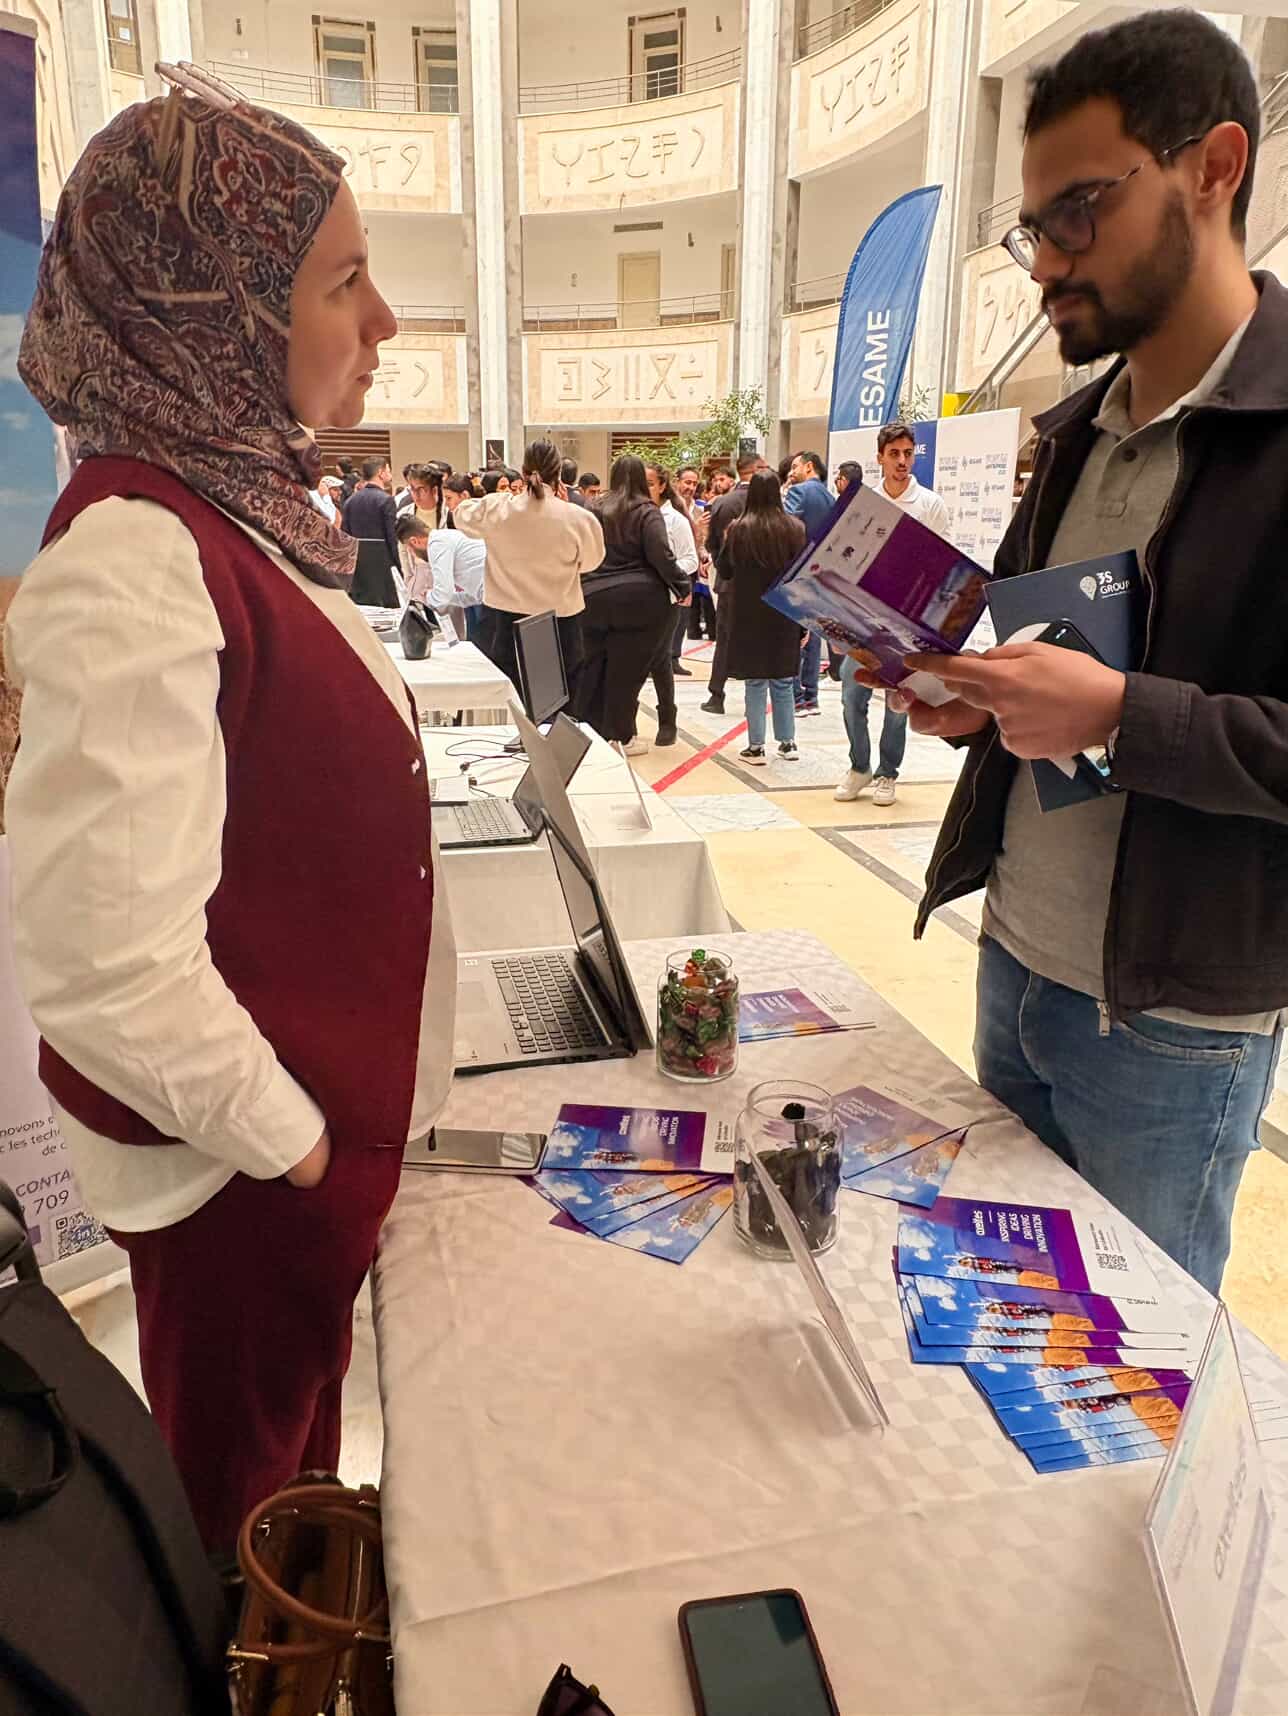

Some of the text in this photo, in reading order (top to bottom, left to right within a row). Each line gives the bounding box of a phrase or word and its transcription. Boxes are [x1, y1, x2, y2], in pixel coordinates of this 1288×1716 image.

[859, 309, 890, 426] ESAME
[1096, 571, 1113, 585] 3S
[9, 1140, 28, 1152] les
[42, 1145, 57, 1156] de
[15, 1169, 72, 1197] CONTA
[33, 1190, 69, 1216] 709
[1032, 1213, 1049, 1253] INNOVATION
